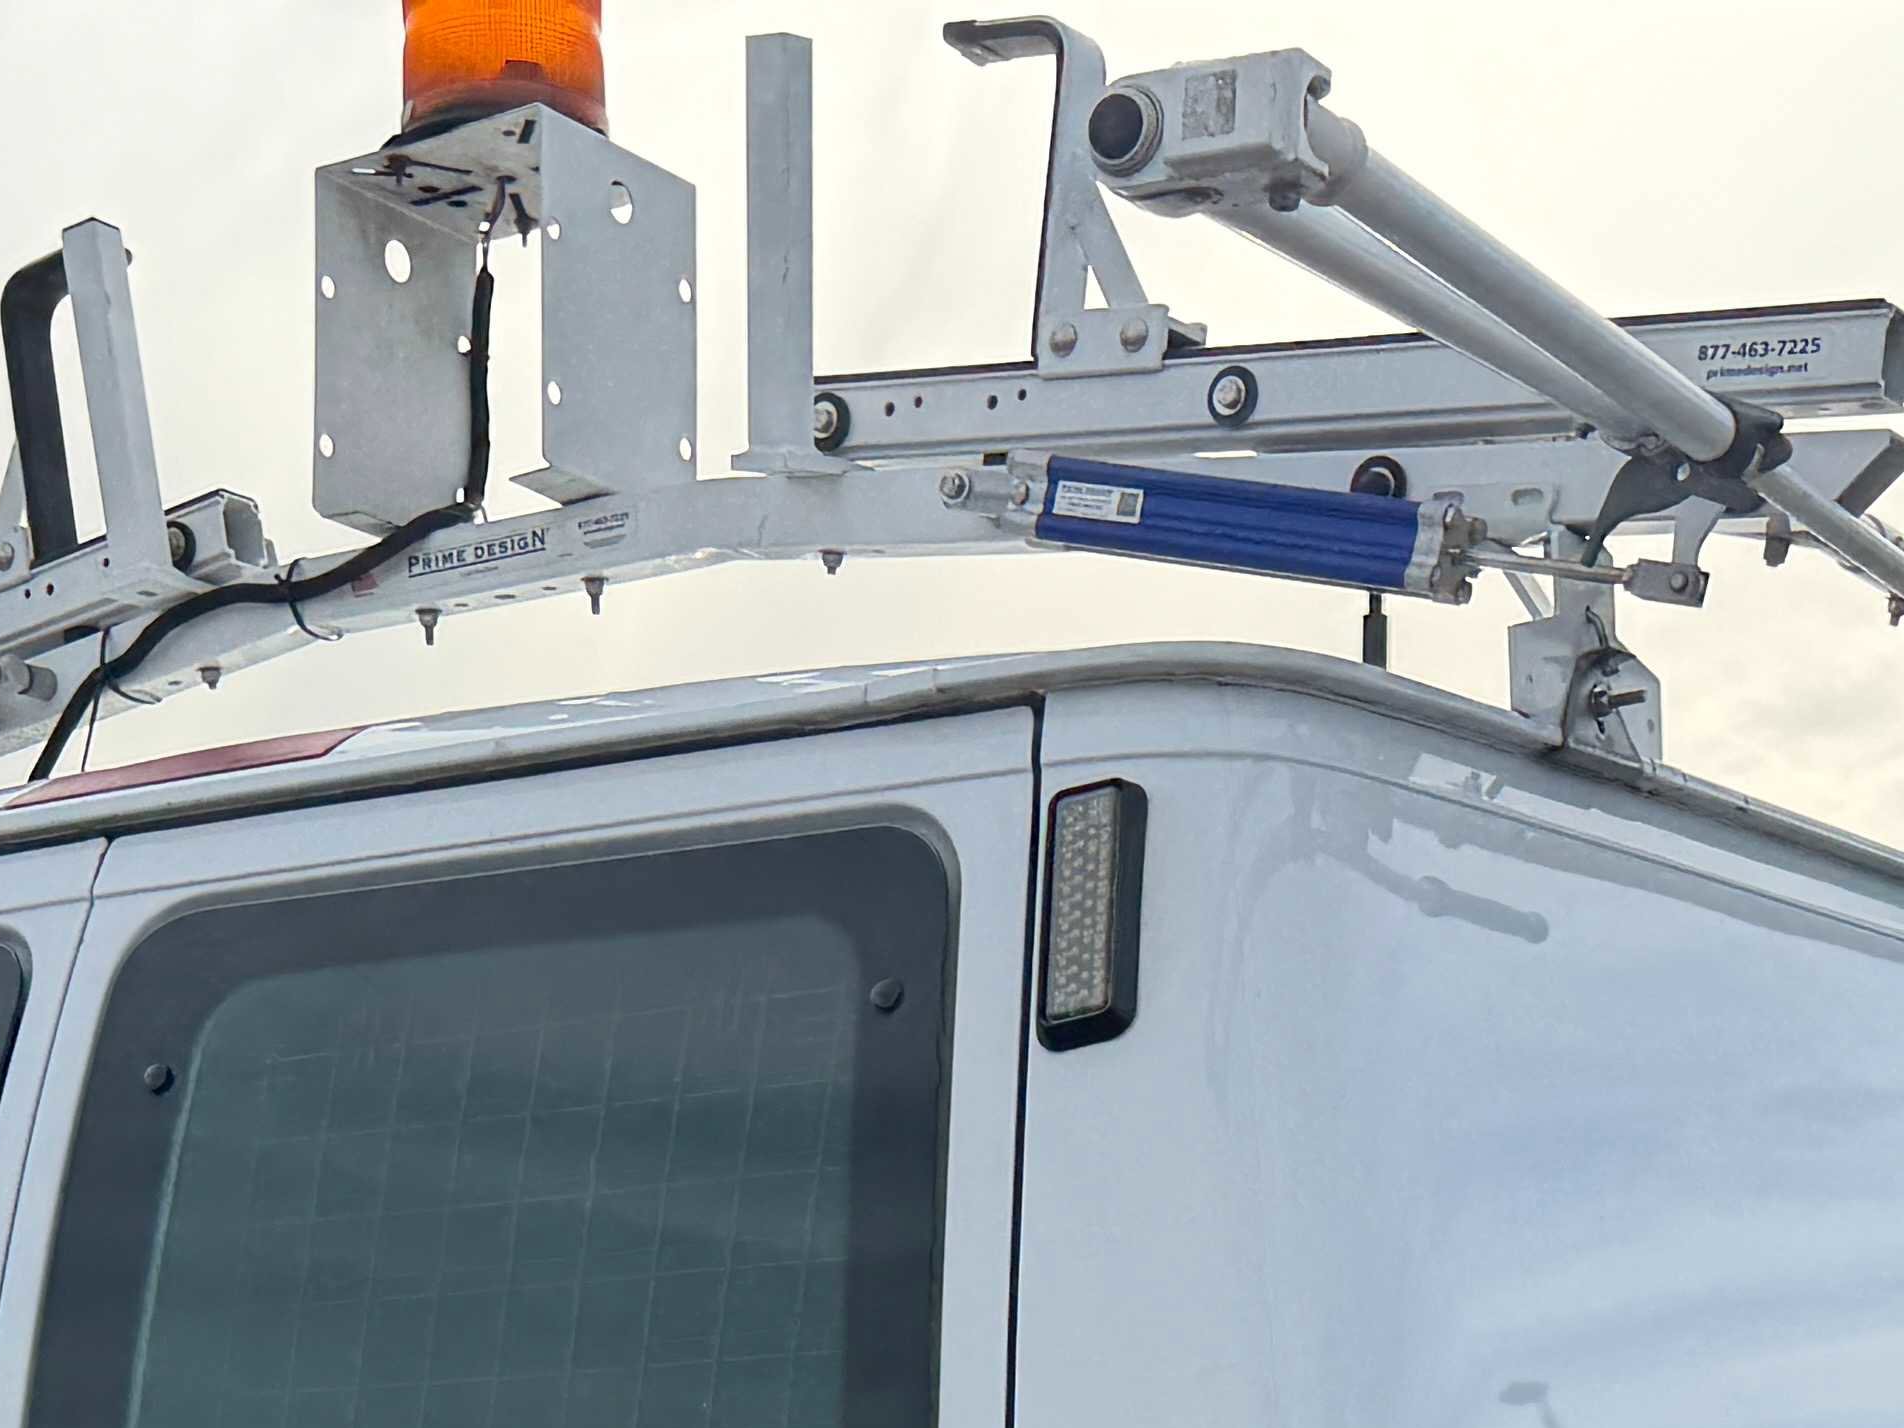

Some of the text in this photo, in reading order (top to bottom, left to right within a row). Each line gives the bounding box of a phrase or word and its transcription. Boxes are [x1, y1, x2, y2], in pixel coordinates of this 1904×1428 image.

[1698, 337, 1822, 361] 877-463-7225
[407, 528, 546, 574] PRIME DESIGN
